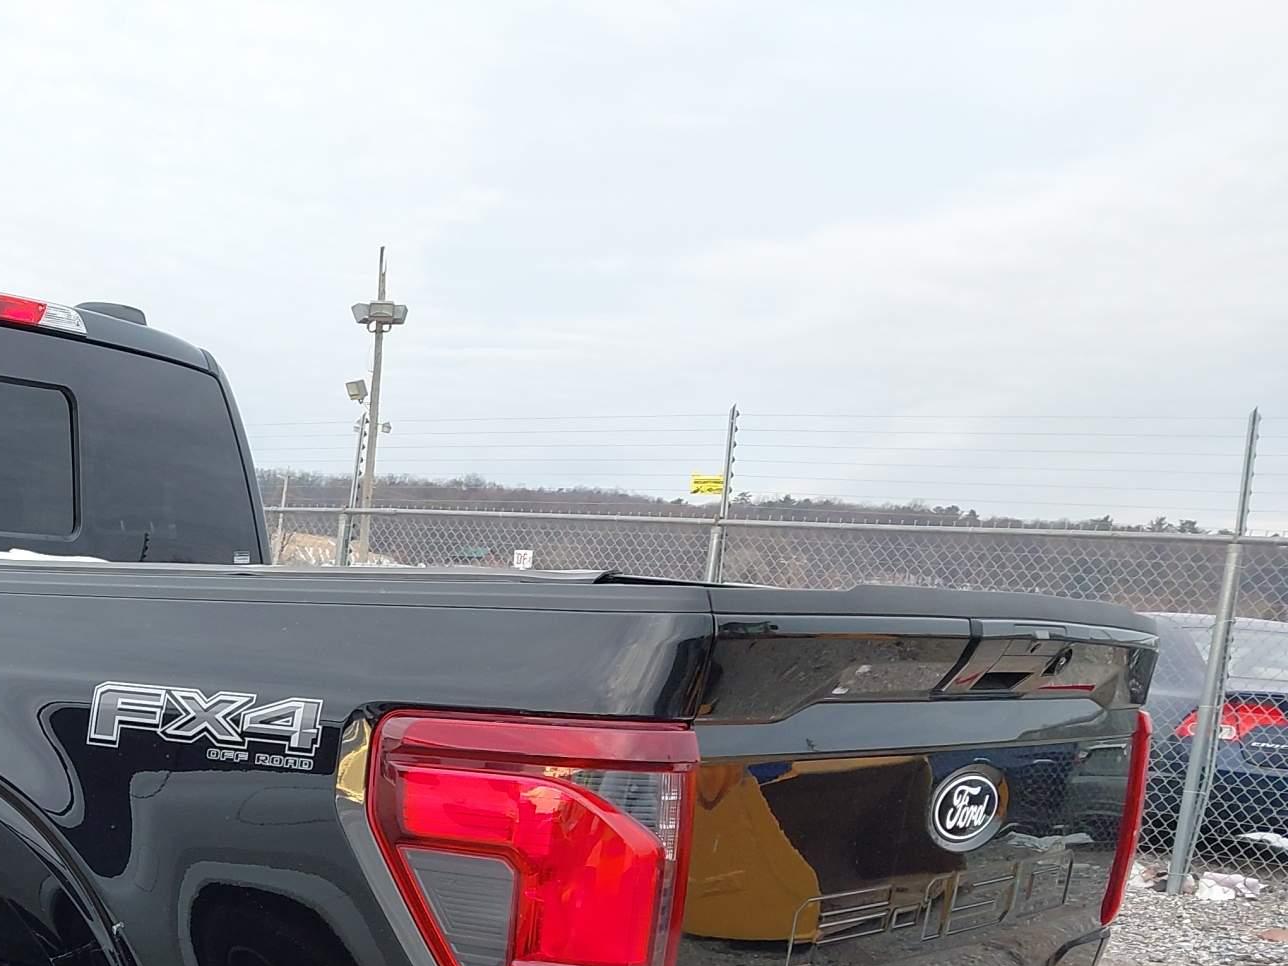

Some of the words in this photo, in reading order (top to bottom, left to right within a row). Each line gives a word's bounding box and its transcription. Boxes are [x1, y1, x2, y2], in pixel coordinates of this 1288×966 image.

[86, 681, 323, 756] FX4
[206, 748, 249, 762] OFF
[254, 753, 314, 771] ROAD
[945, 784, 990, 830] Ford
